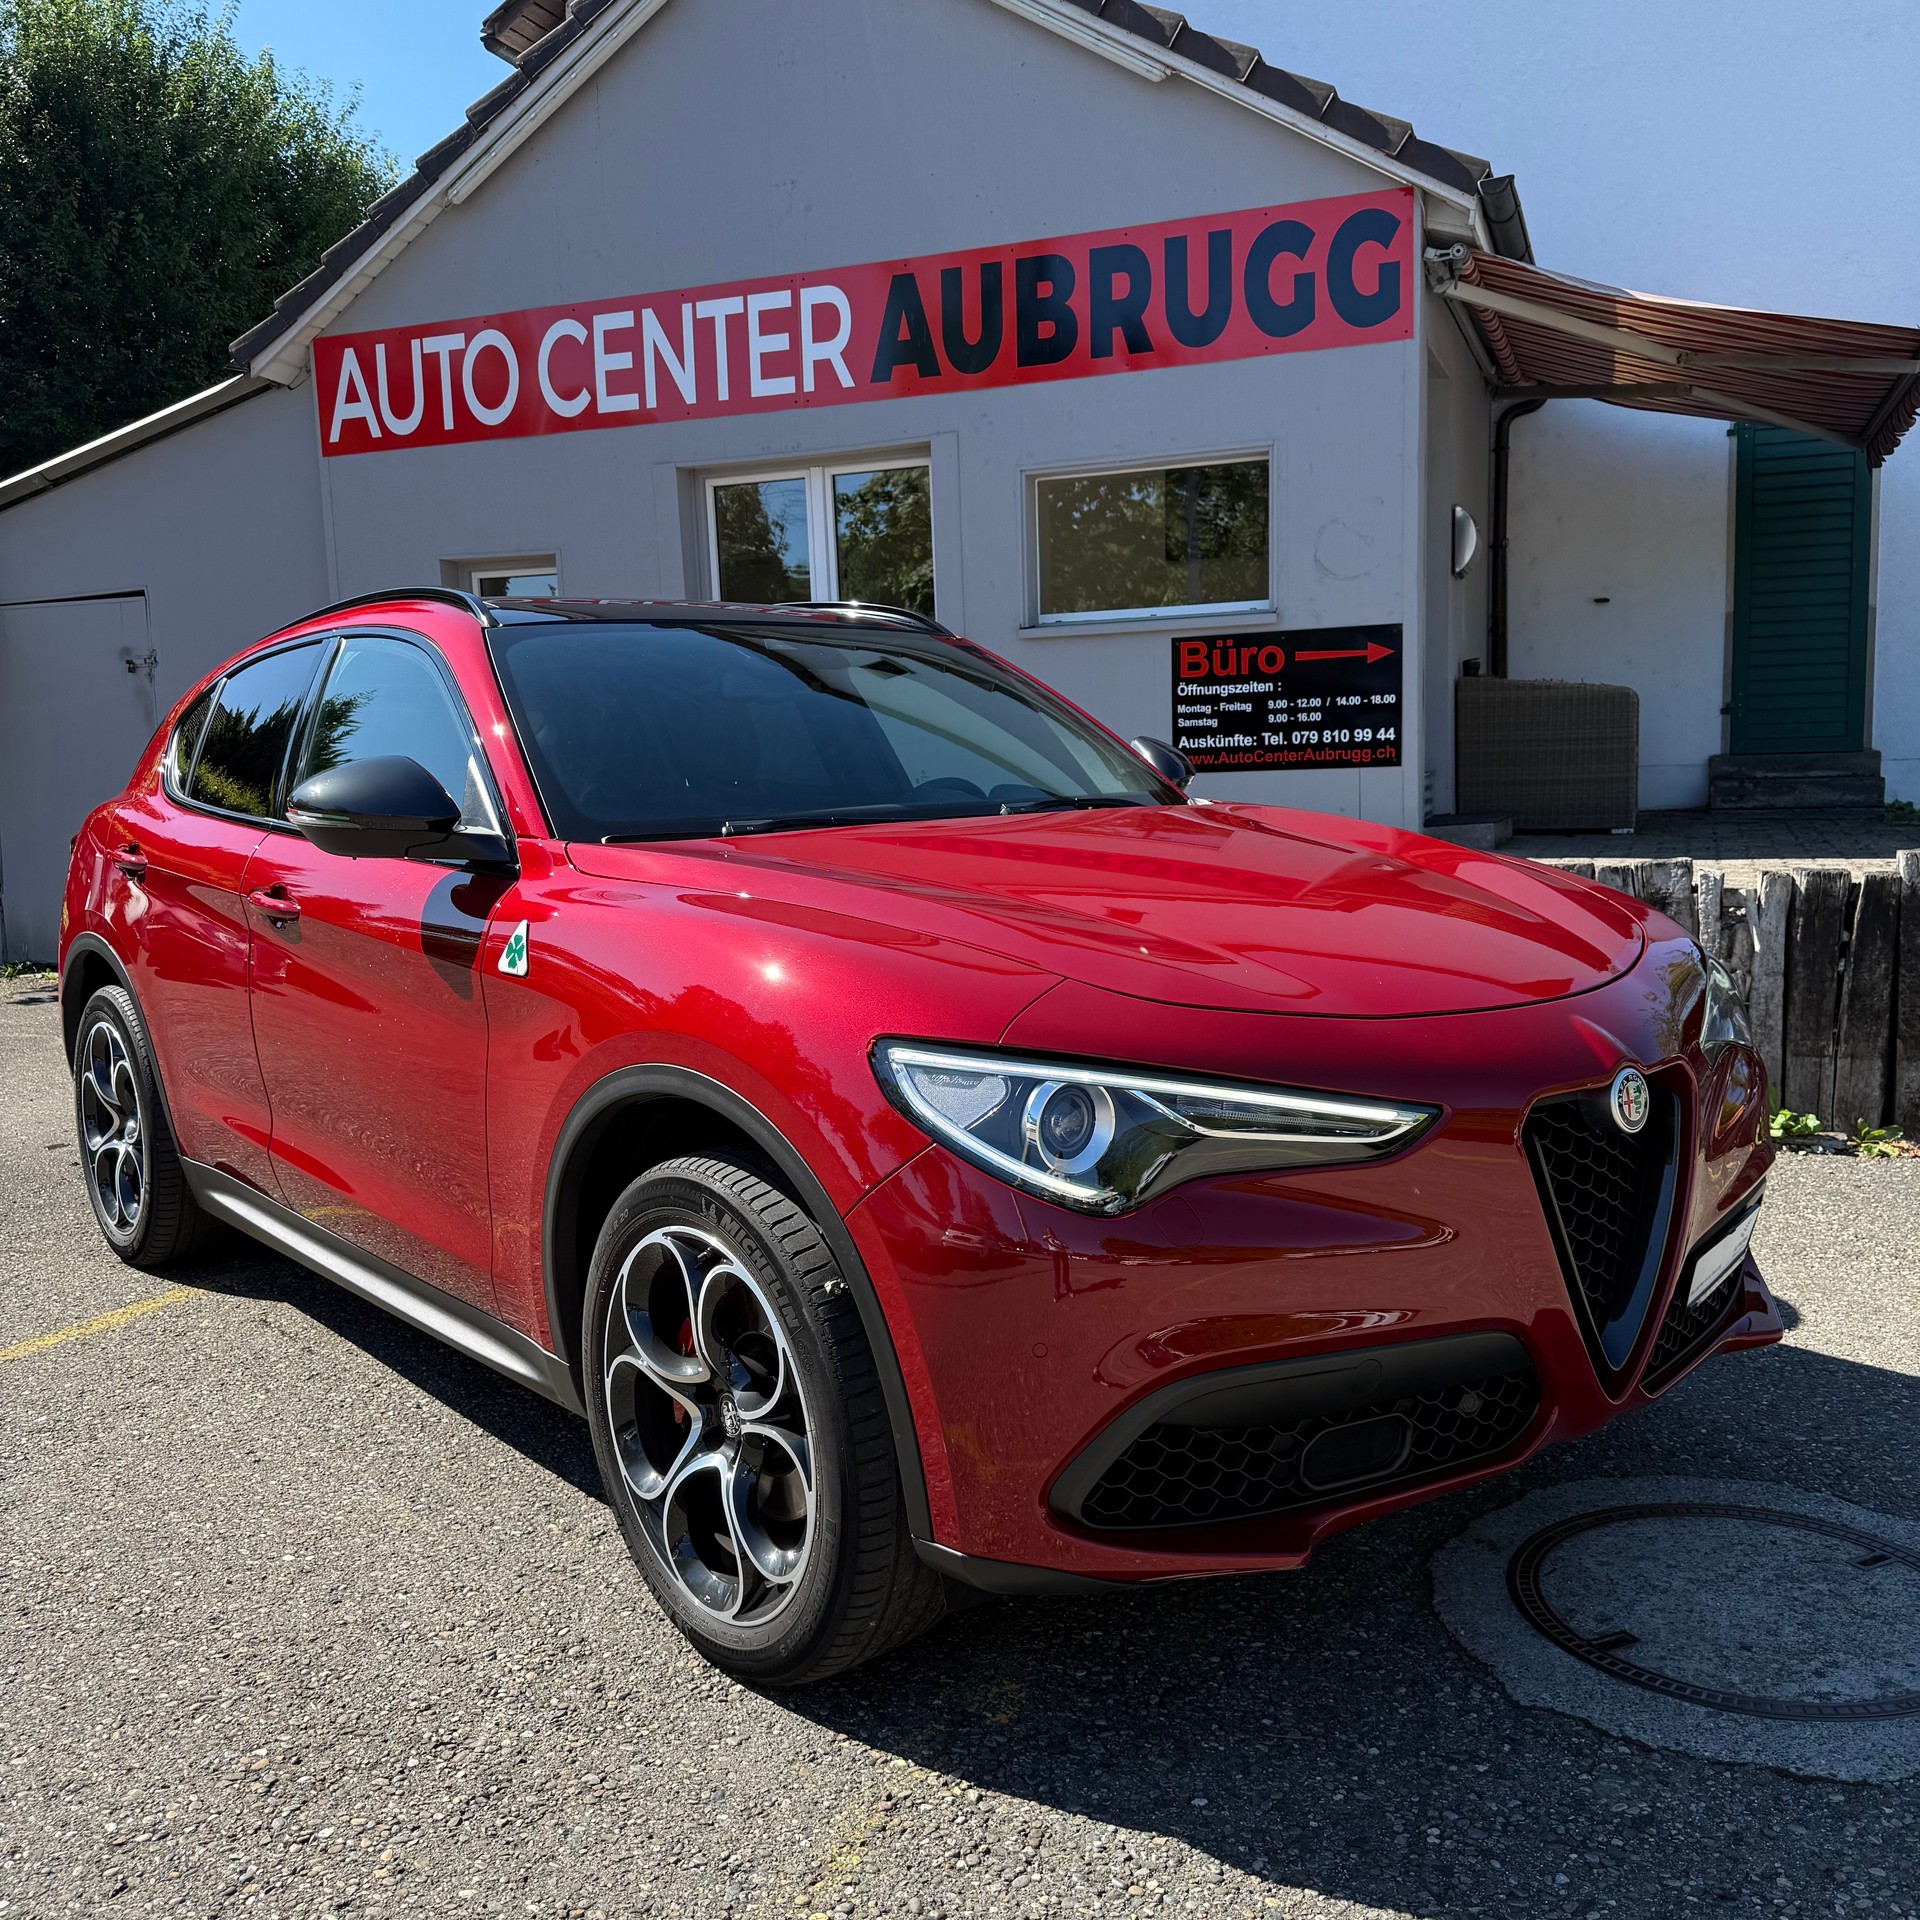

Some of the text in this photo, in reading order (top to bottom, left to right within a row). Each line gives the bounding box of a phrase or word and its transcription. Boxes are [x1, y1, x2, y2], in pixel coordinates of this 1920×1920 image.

[329, 208, 1401, 443] AUTO CENTER AUBRUGG
[1180, 639, 1285, 678] Büro
[1177, 682, 1274, 697] Öffnungszeiten
[1177, 704, 1212, 714] Montag
[1220, 702, 1252, 712] Freitag
[1268, 700, 1288, 709] 9.00
[1296, 698, 1321, 708] 12.00
[1335, 696, 1361, 706] 14.00
[1370, 694, 1396, 704] 18.00
[1178, 718, 1218, 728] Samstag
[1268, 713, 1288, 723] 9.00
[1297, 712, 1322, 722] 16.00
[1178, 727, 1396, 749] Auskünfte: Tel. 079 810 99 44
[1187, 745, 1396, 765] ww.AutoCenterAubrugg.ch
[720, 1213, 801, 1328] MICHELIN
